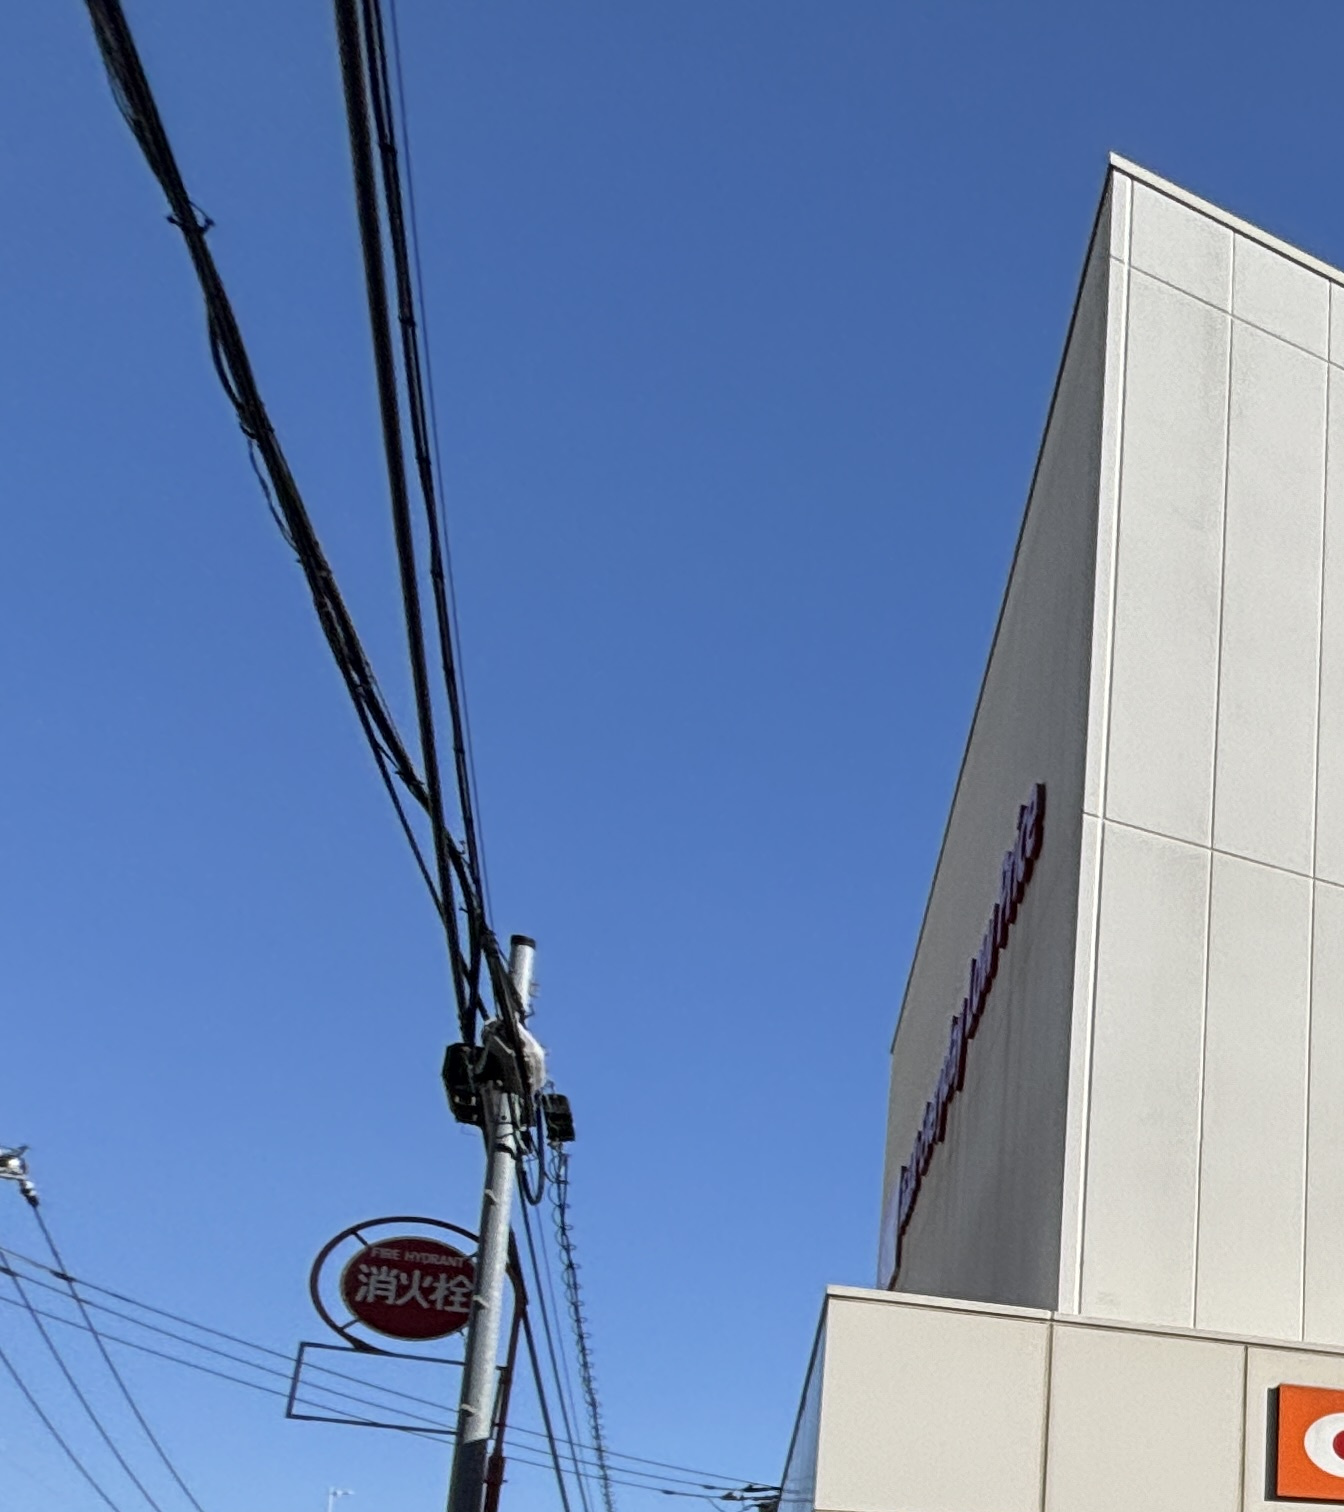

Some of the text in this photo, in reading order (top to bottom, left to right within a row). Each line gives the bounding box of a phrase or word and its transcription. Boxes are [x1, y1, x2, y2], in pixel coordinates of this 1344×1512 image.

[371, 1247, 465, 1267] FIRE HYDRANT
[355, 1264, 475, 1313] 消火栓
